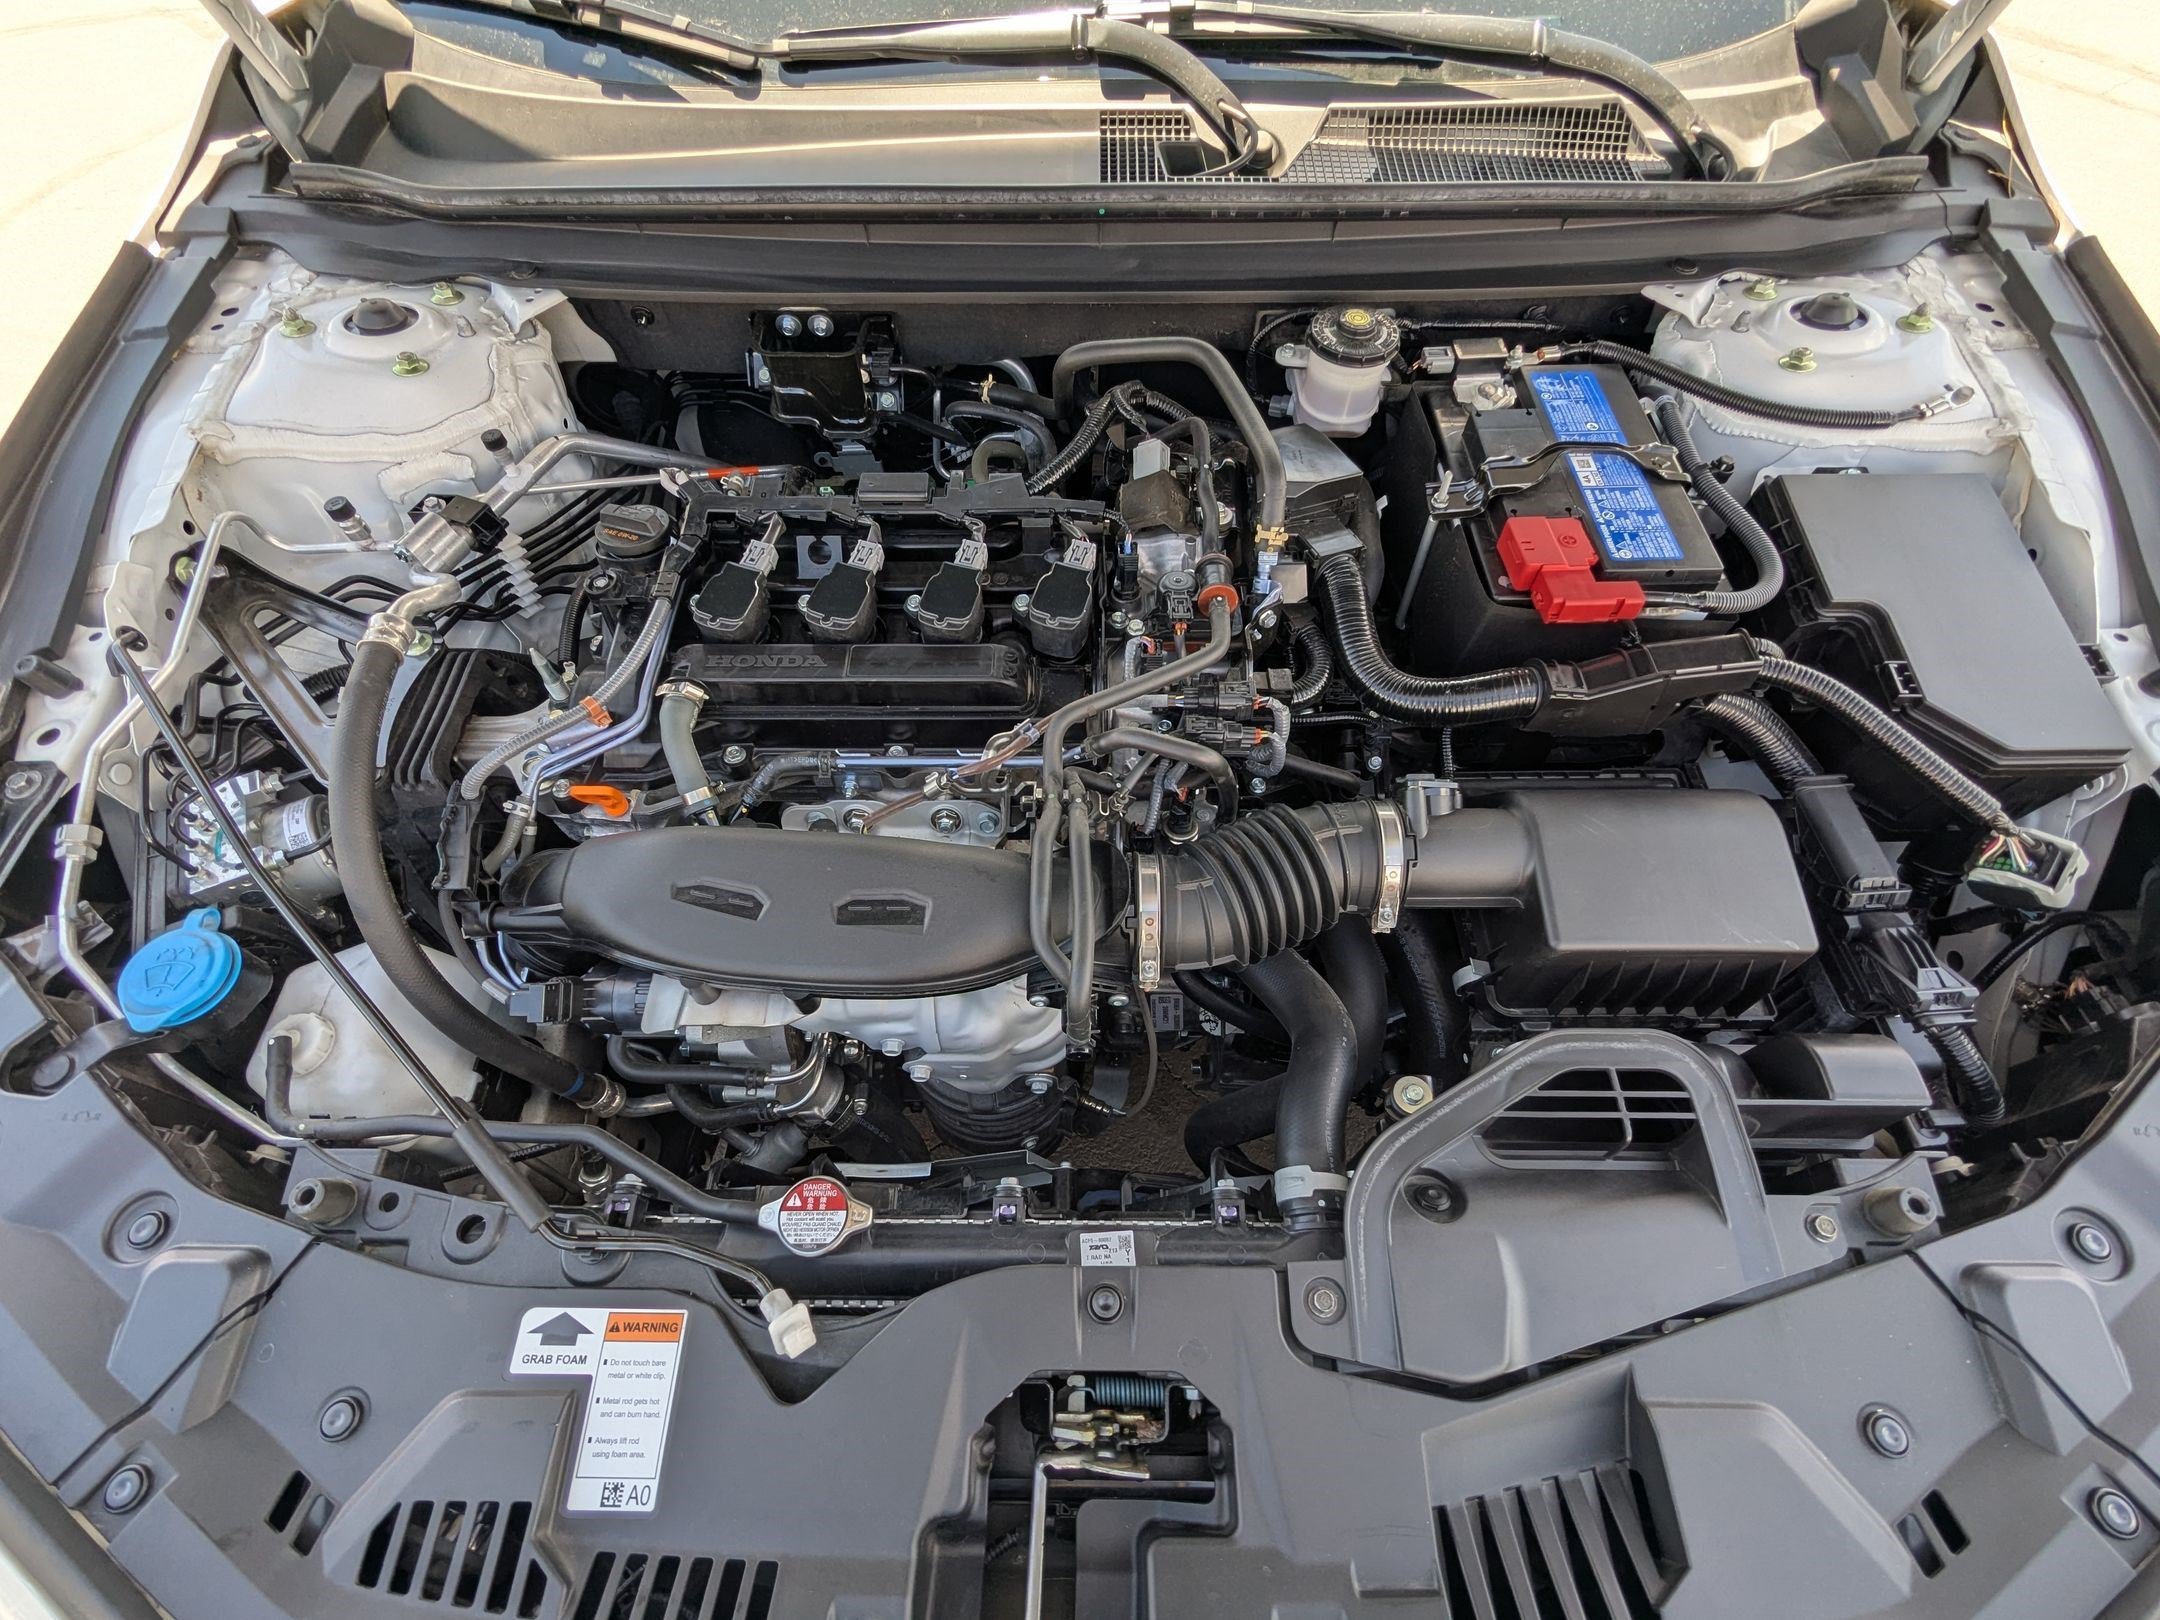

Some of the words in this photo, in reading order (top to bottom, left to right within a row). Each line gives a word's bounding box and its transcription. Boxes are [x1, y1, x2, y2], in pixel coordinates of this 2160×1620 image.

[704, 654, 828, 668] HONDA
[623, 1322, 678, 1333] WARNING
[522, 1354, 552, 1364] GRAB
[556, 1354, 587, 1364] FOAM
[634, 1398, 648, 1406] gets
[594, 1437, 618, 1445] Always
[625, 1484, 651, 1506] A0
